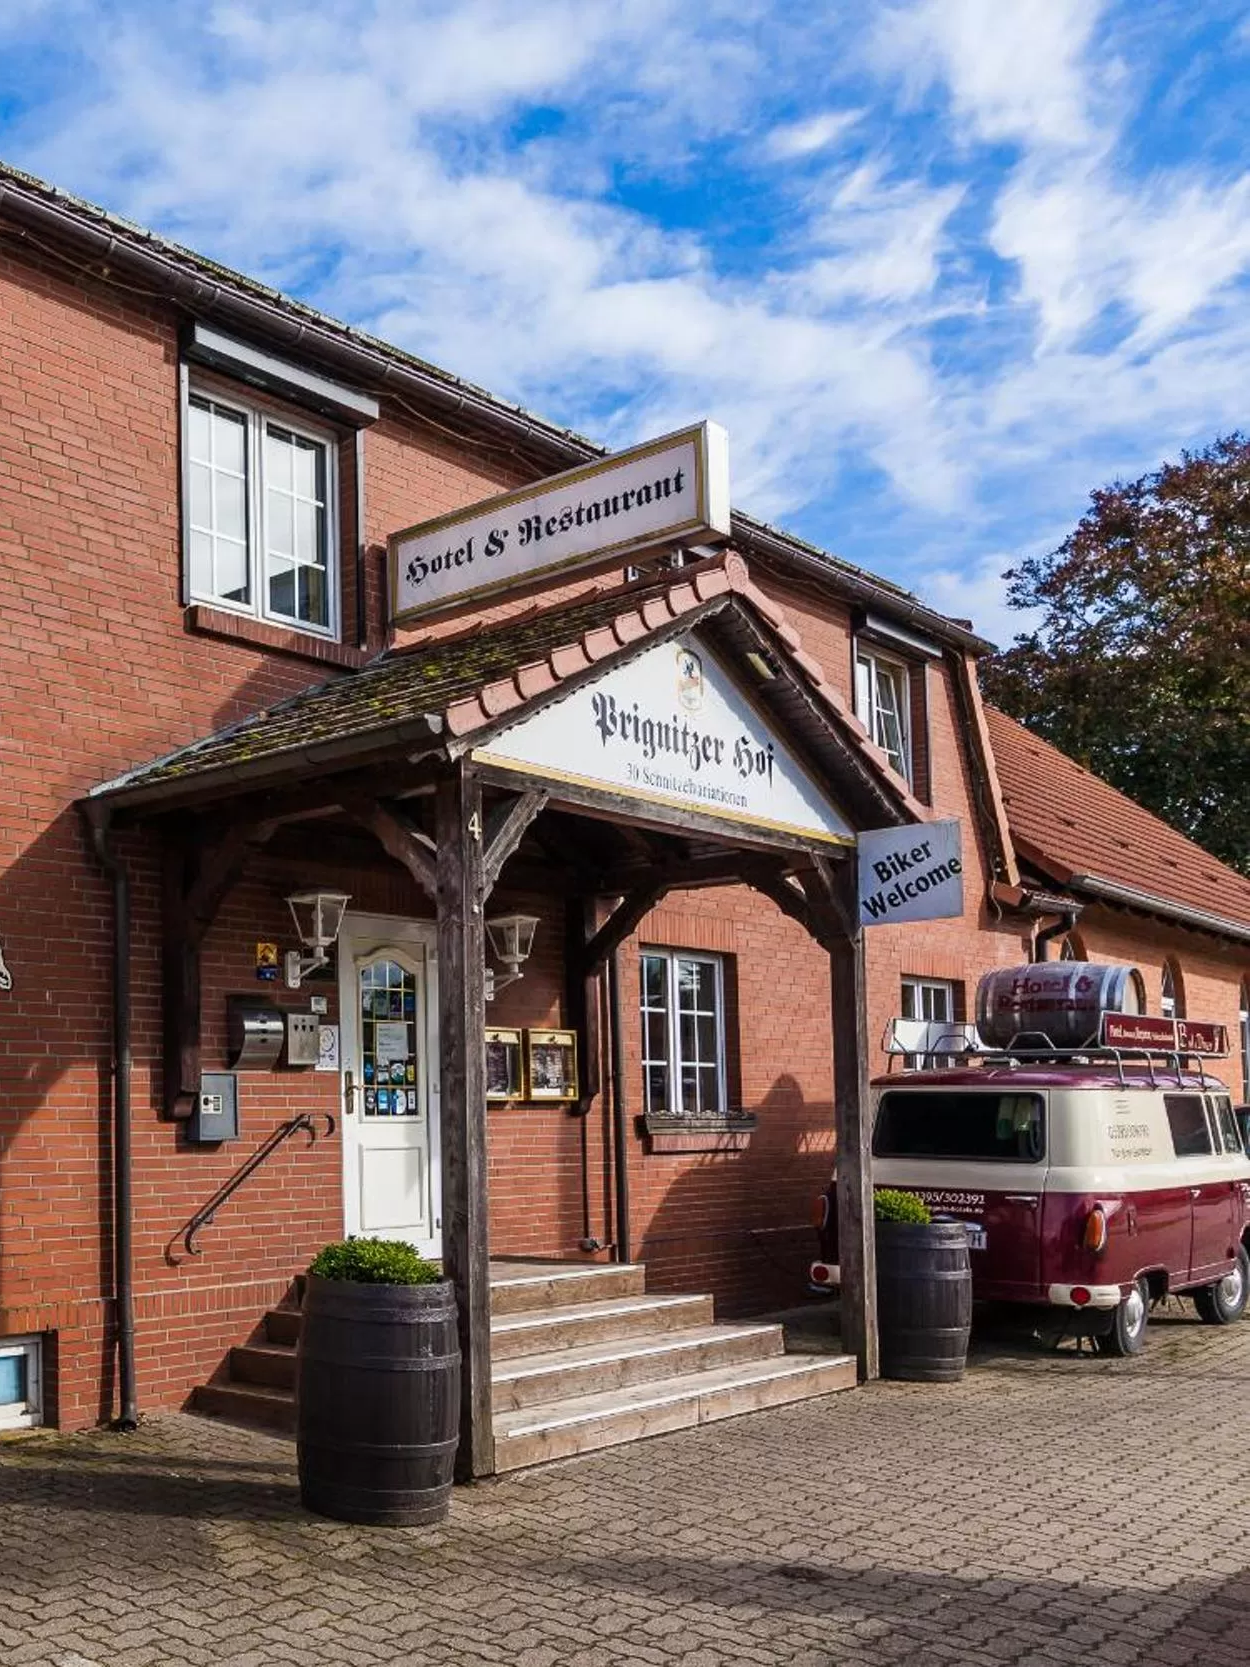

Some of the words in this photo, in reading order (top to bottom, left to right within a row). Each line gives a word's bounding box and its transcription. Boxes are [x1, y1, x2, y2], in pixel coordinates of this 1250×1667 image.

[406, 537, 476, 588] Hotel
[484, 528, 510, 558] &
[518, 466, 685, 547] Restaurant
[591, 691, 725, 771] Prignitzer
[733, 735, 775, 788] Hof
[468, 811, 483, 841] 4
[862, 858, 963, 919] Welcome
[872, 840, 932, 885] Biker
